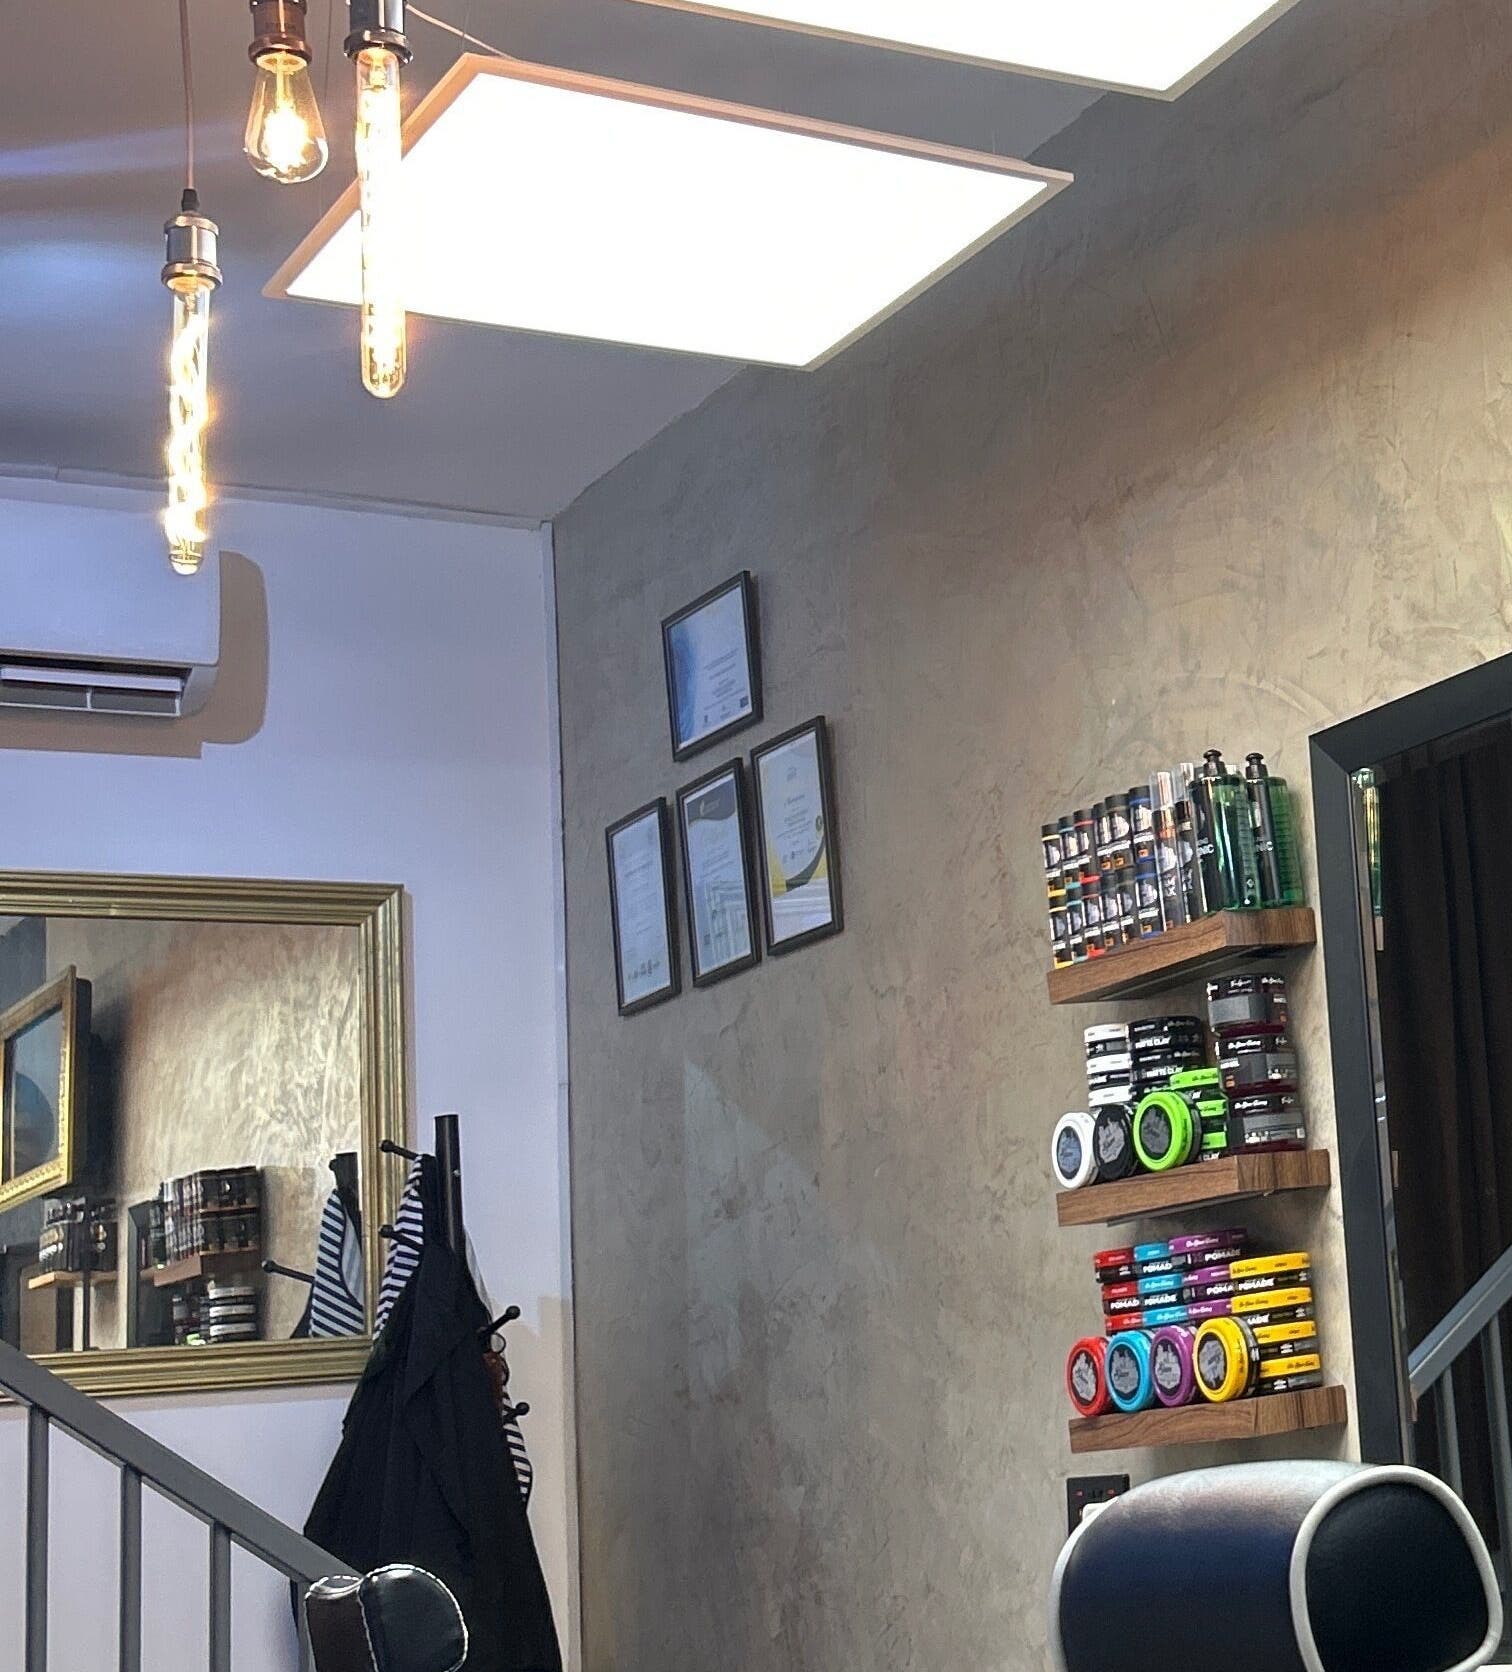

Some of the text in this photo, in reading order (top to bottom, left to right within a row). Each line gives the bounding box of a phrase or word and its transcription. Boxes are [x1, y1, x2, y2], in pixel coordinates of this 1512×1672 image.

[1143, 1262, 1172, 1273] POMAD
[1206, 1285, 1233, 1296] POMA
[1110, 1298, 1140, 1309] POMAD
